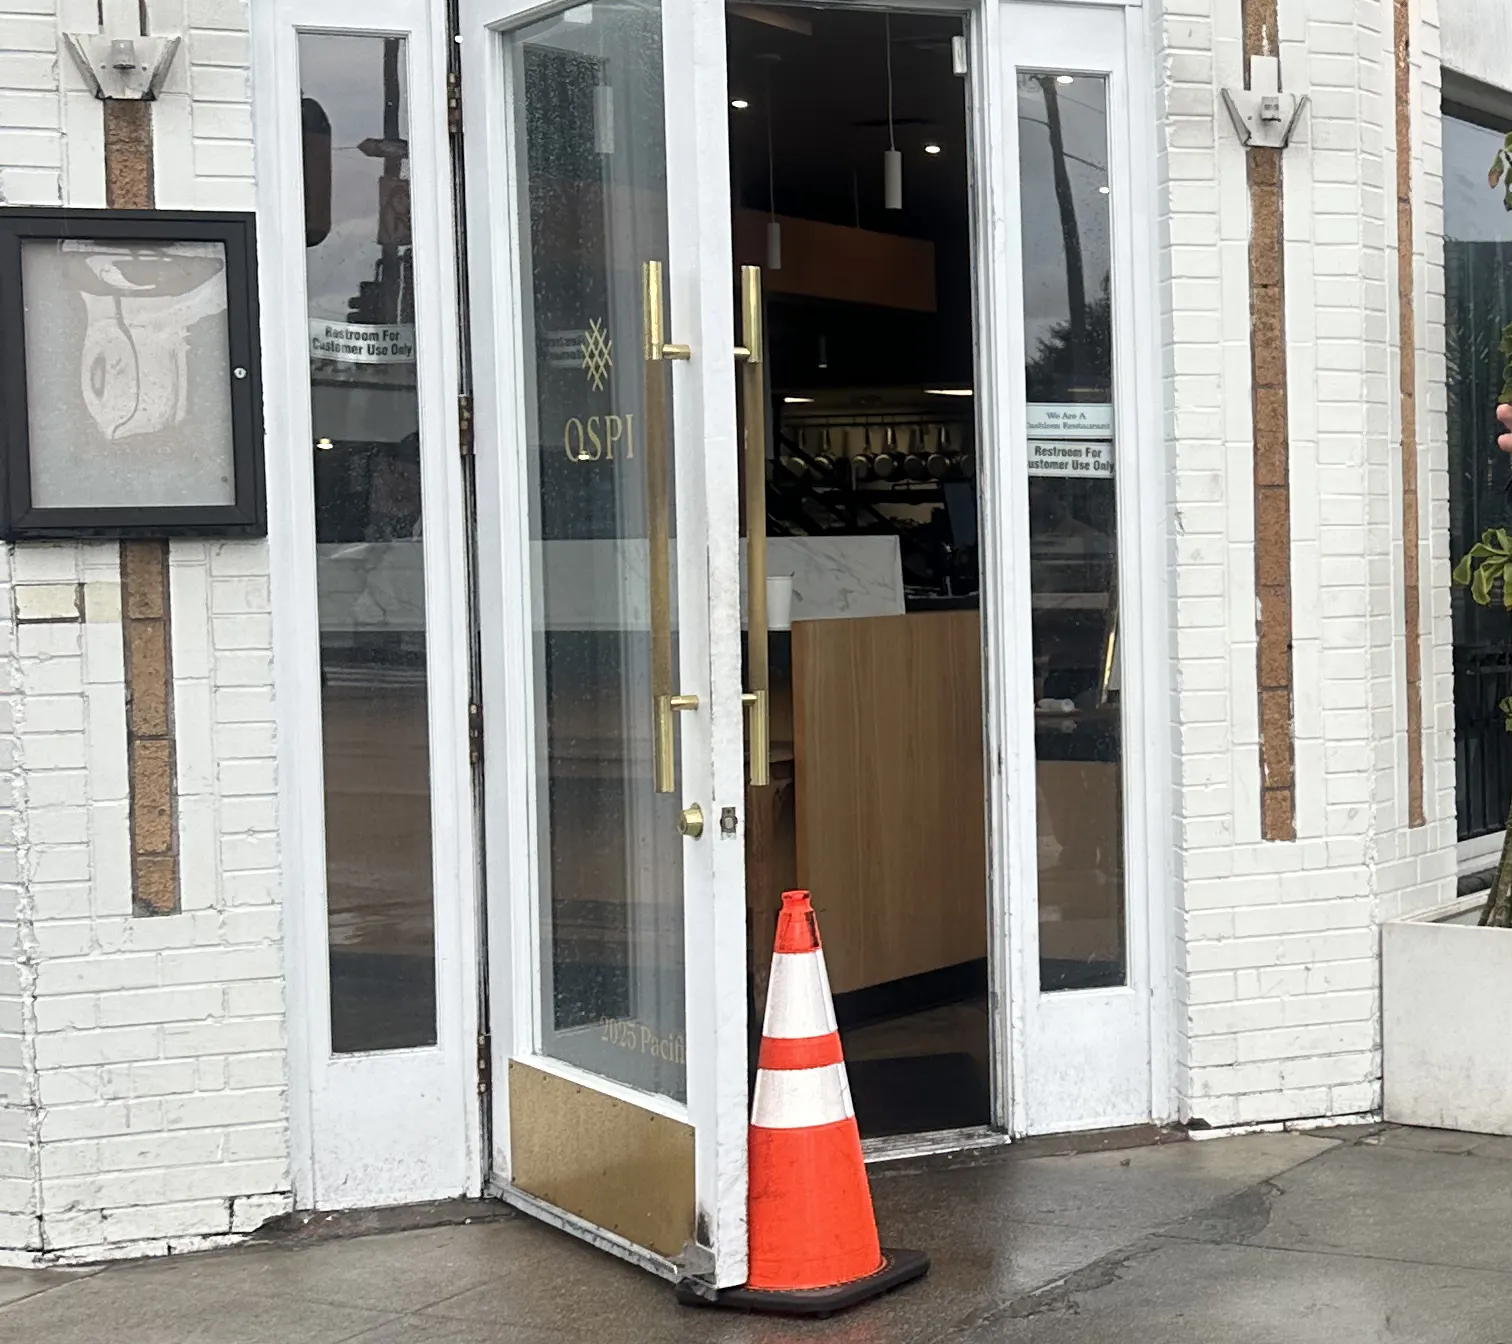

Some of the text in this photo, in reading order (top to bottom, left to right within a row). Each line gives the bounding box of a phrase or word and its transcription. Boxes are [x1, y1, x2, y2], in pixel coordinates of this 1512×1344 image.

[382, 329, 400, 342] For
[367, 343, 389, 356] Use
[1046, 411, 1087, 420] We Are A
[564, 413, 634, 462] OSPI
[1034, 445, 1103, 459] Restroom For
[1028, 459, 1115, 474] ustomer Use Only
[600, 1015, 685, 1065] 2025 Pacifi
